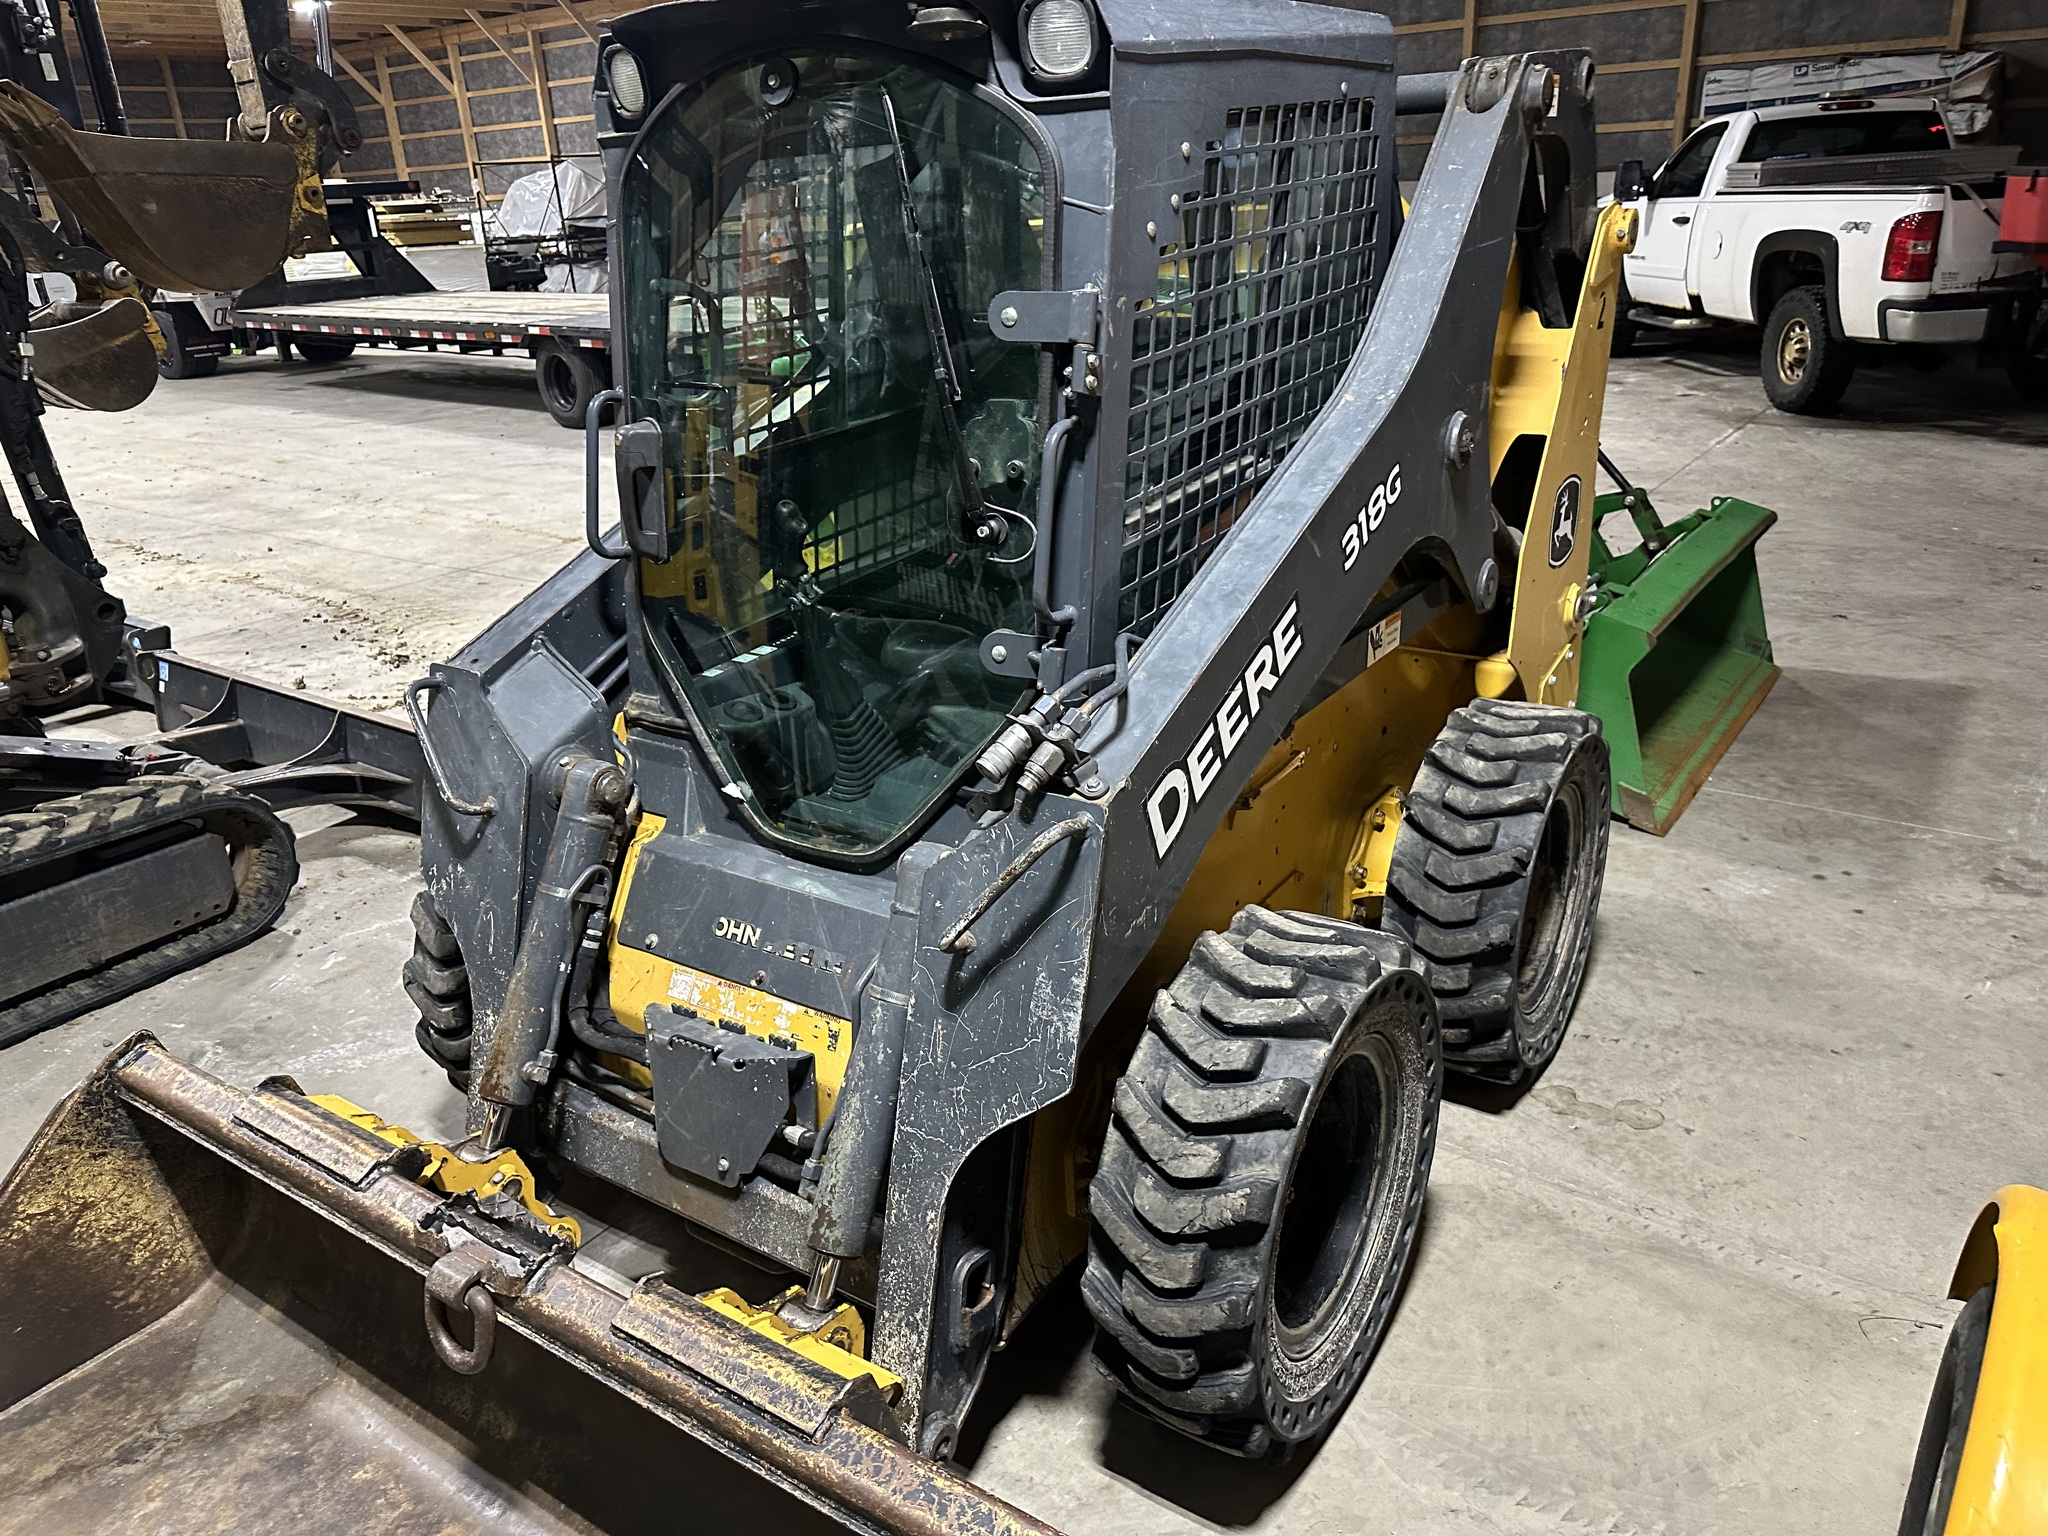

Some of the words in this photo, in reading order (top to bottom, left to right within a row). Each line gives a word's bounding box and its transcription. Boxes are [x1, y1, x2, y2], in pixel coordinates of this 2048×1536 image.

[1341, 463, 1401, 572] 318G
[1147, 600, 1302, 860] DEERE
[813, 1009, 841, 1025] WARNING
